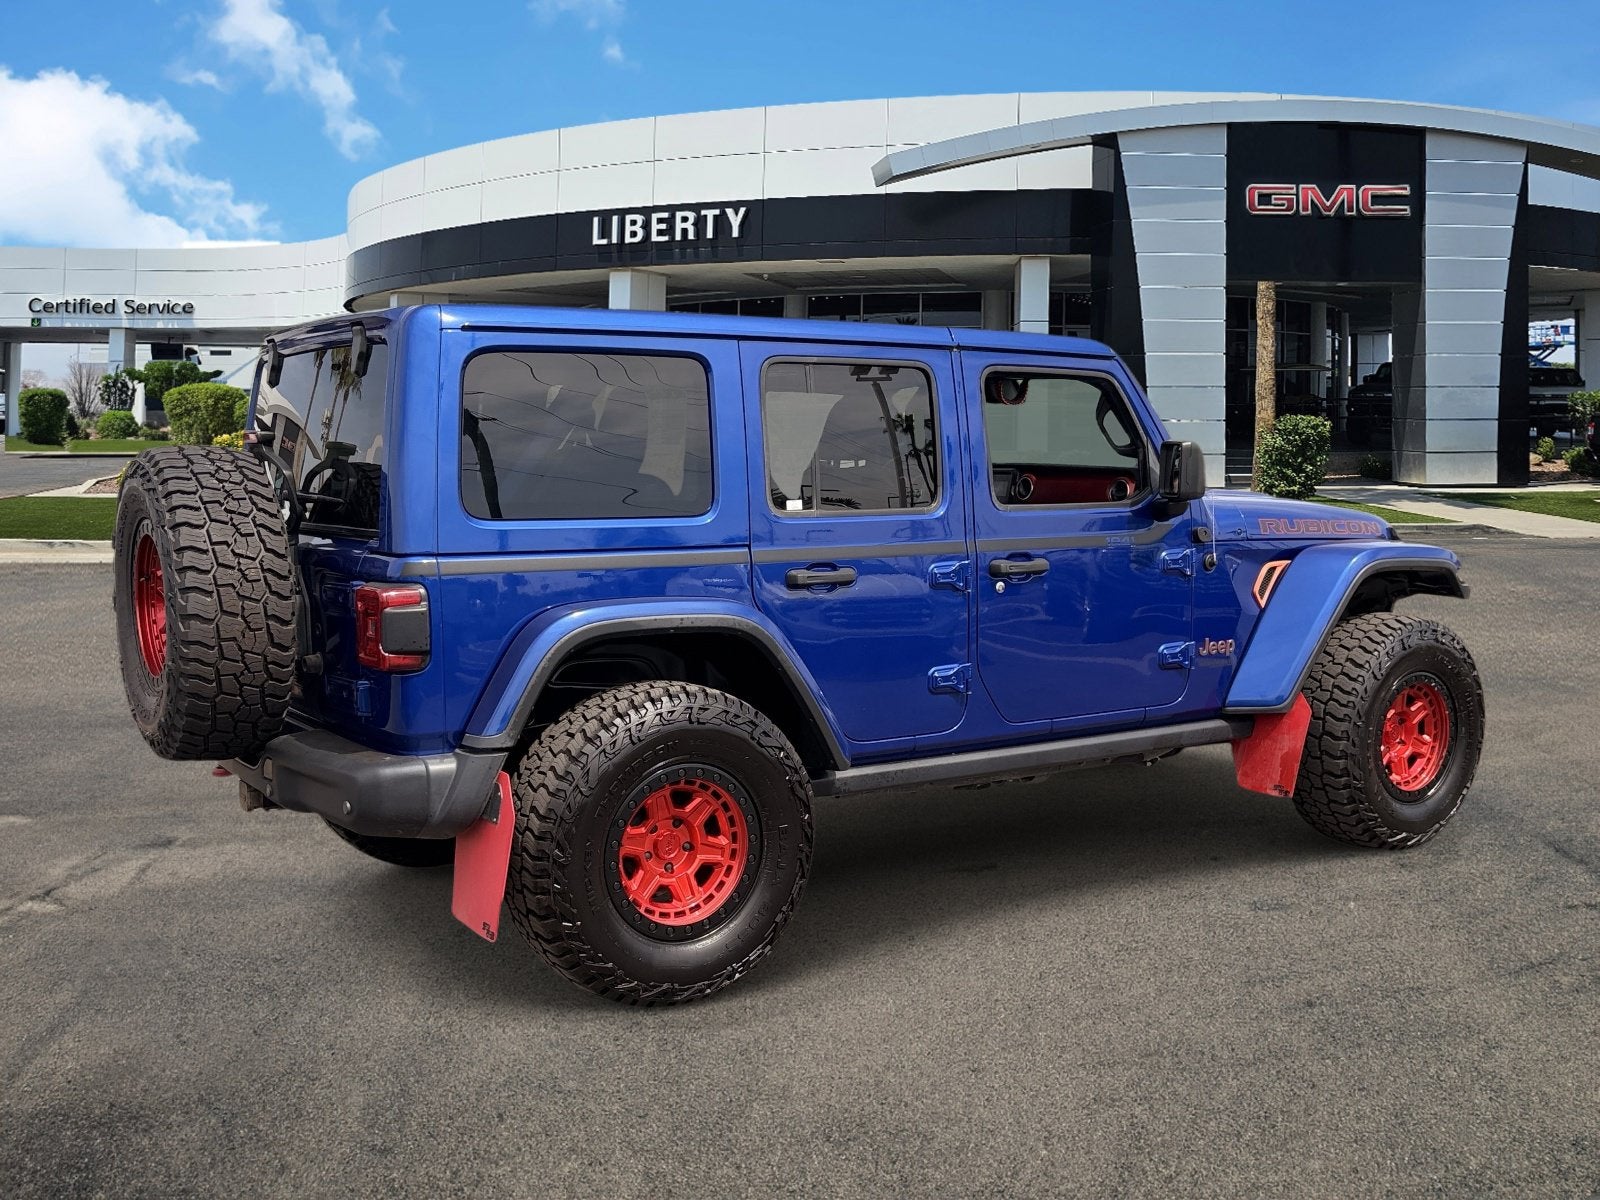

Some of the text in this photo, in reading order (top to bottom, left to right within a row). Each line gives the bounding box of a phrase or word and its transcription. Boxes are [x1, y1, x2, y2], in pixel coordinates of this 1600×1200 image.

[1246, 183, 1411, 217] GMC
[592, 207, 747, 246] LIBERTY
[28, 297, 194, 314] Certified Service
[1258, 518, 1380, 536] RUBICON
[1199, 637, 1235, 656] Jeep
